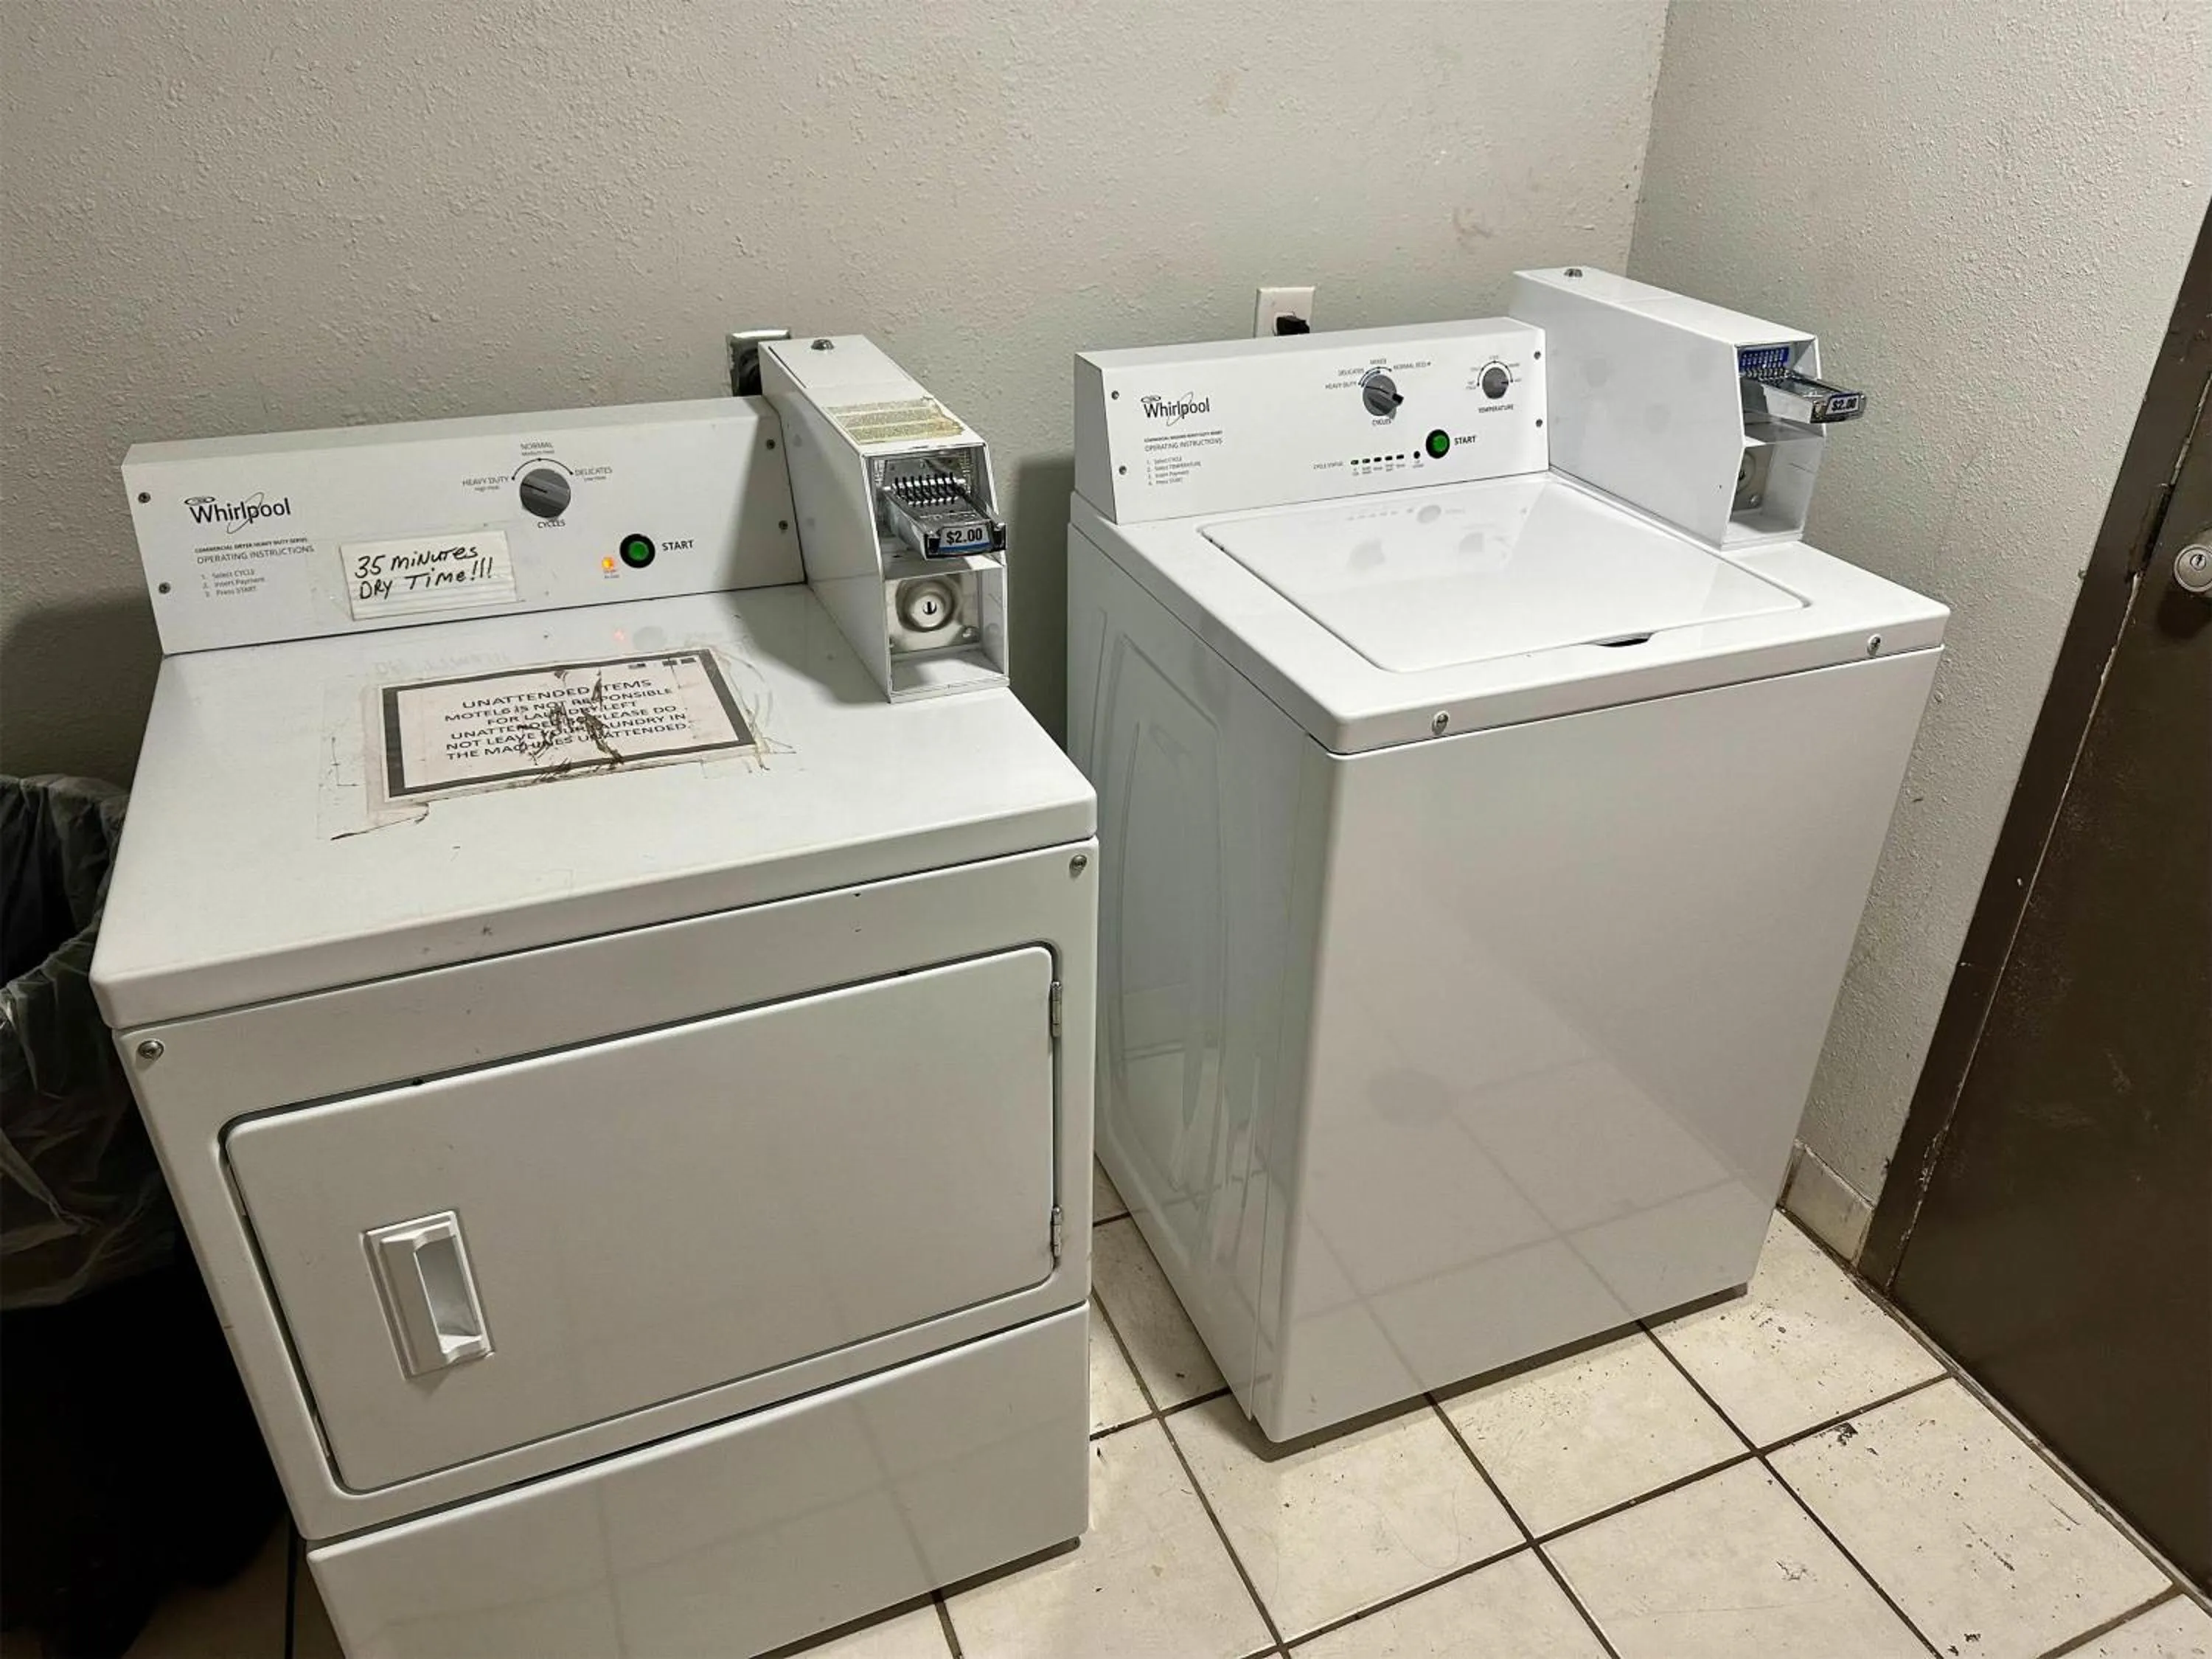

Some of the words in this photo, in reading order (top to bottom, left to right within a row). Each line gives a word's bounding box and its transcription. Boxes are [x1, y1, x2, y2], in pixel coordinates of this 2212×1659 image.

[1144, 397, 1211, 419] Whirlpool
[1454, 435, 1476, 445] START
[574, 466, 613, 476] DELICATES
[462, 478, 486, 487] HEAVY
[486, 476, 509, 484] DUTY
[189, 497, 291, 524] Whirlpool
[537, 518, 566, 529] CYCLES
[661, 539, 695, 552] START
[946, 527, 983, 546] $2.00
[197, 552, 248, 565] OPERATING
[249, 545, 315, 560] INSTRUCTIONS
[355, 554, 386, 579] 35
[359, 579, 393, 599] DRY
[462, 686, 591, 709] UNATTENDED
[596, 679, 653, 692] TEMS
[571, 688, 673, 706] REPONSIBLE
[487, 716, 520, 726] FOR
[524, 703, 599, 720] LAUDRY
[602, 700, 637, 711] LEFT
[653, 705, 676, 714] DO
[446, 740, 482, 751] NOT
[487, 732, 538, 746] LEAVE
[597, 715, 665, 729] AUNDRY
[669, 713, 686, 721] IN
[446, 750, 480, 760] THE
